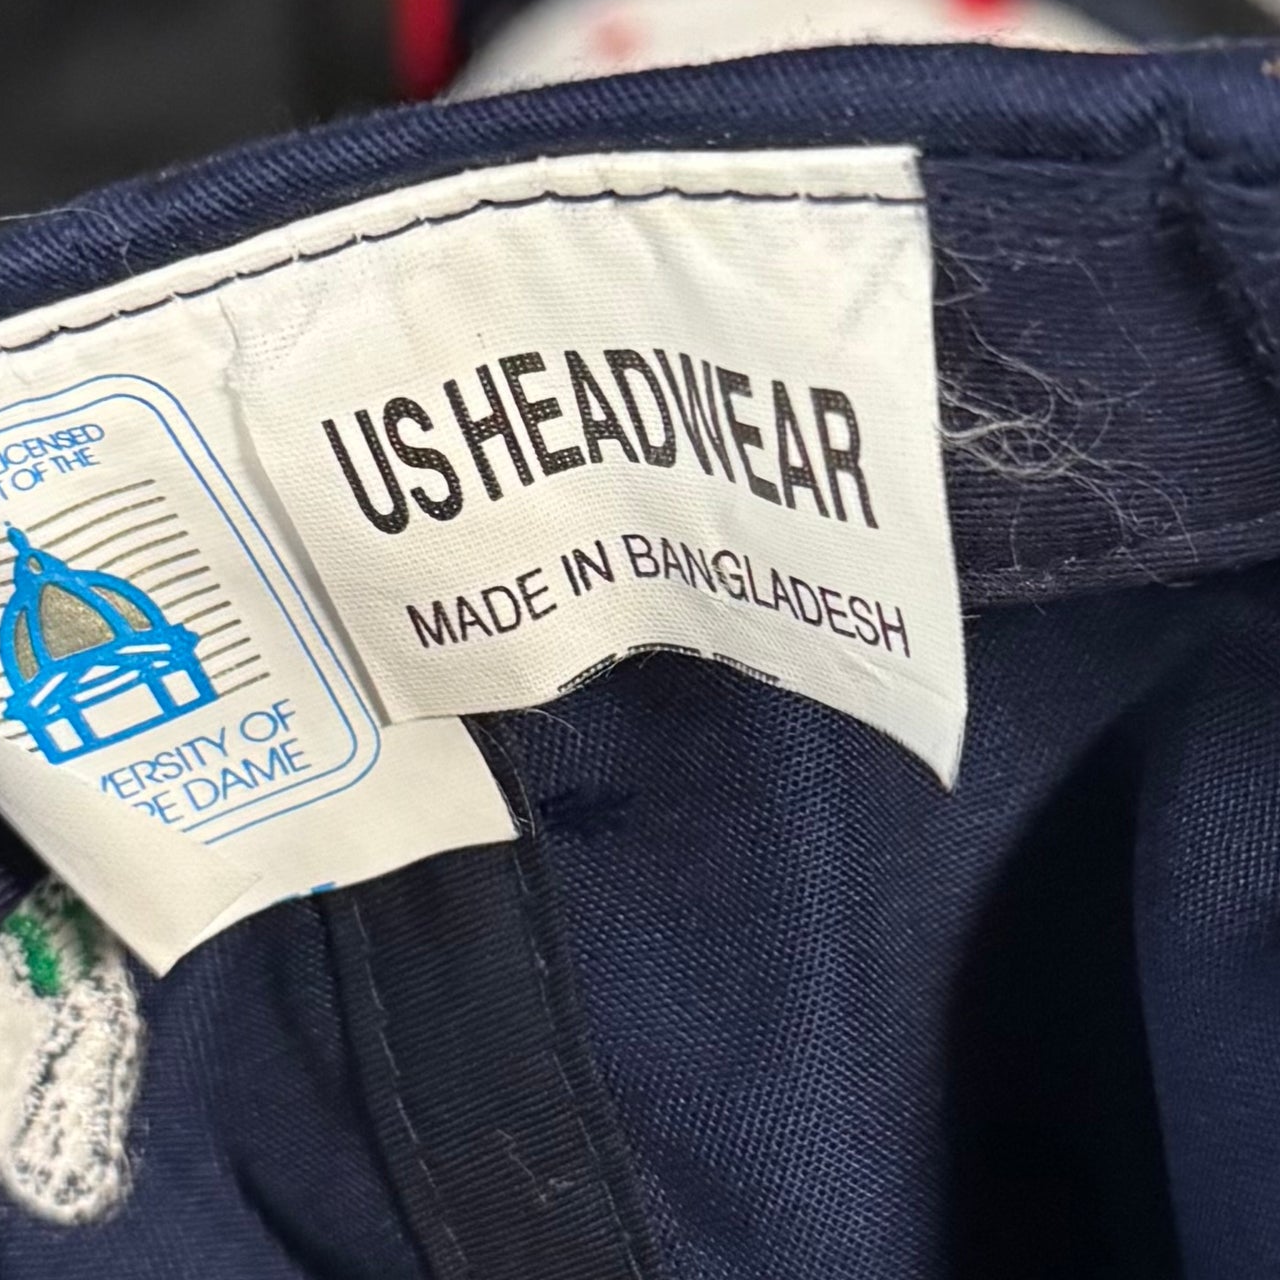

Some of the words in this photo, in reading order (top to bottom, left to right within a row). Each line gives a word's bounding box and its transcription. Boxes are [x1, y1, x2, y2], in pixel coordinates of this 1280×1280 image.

[11, 461, 48, 491] OF
[50, 447, 100, 473] THE
[322, 397, 463, 534] US
[443, 348, 879, 529] HEADWEAR
[406, 568, 557, 648] MADE
[562, 540, 615, 595] IN
[621, 534, 910, 657] BANGLADESH
[101, 726, 228, 799] ERSITY
[240, 698, 296, 742] OF
[183, 738, 312, 811] DAME
